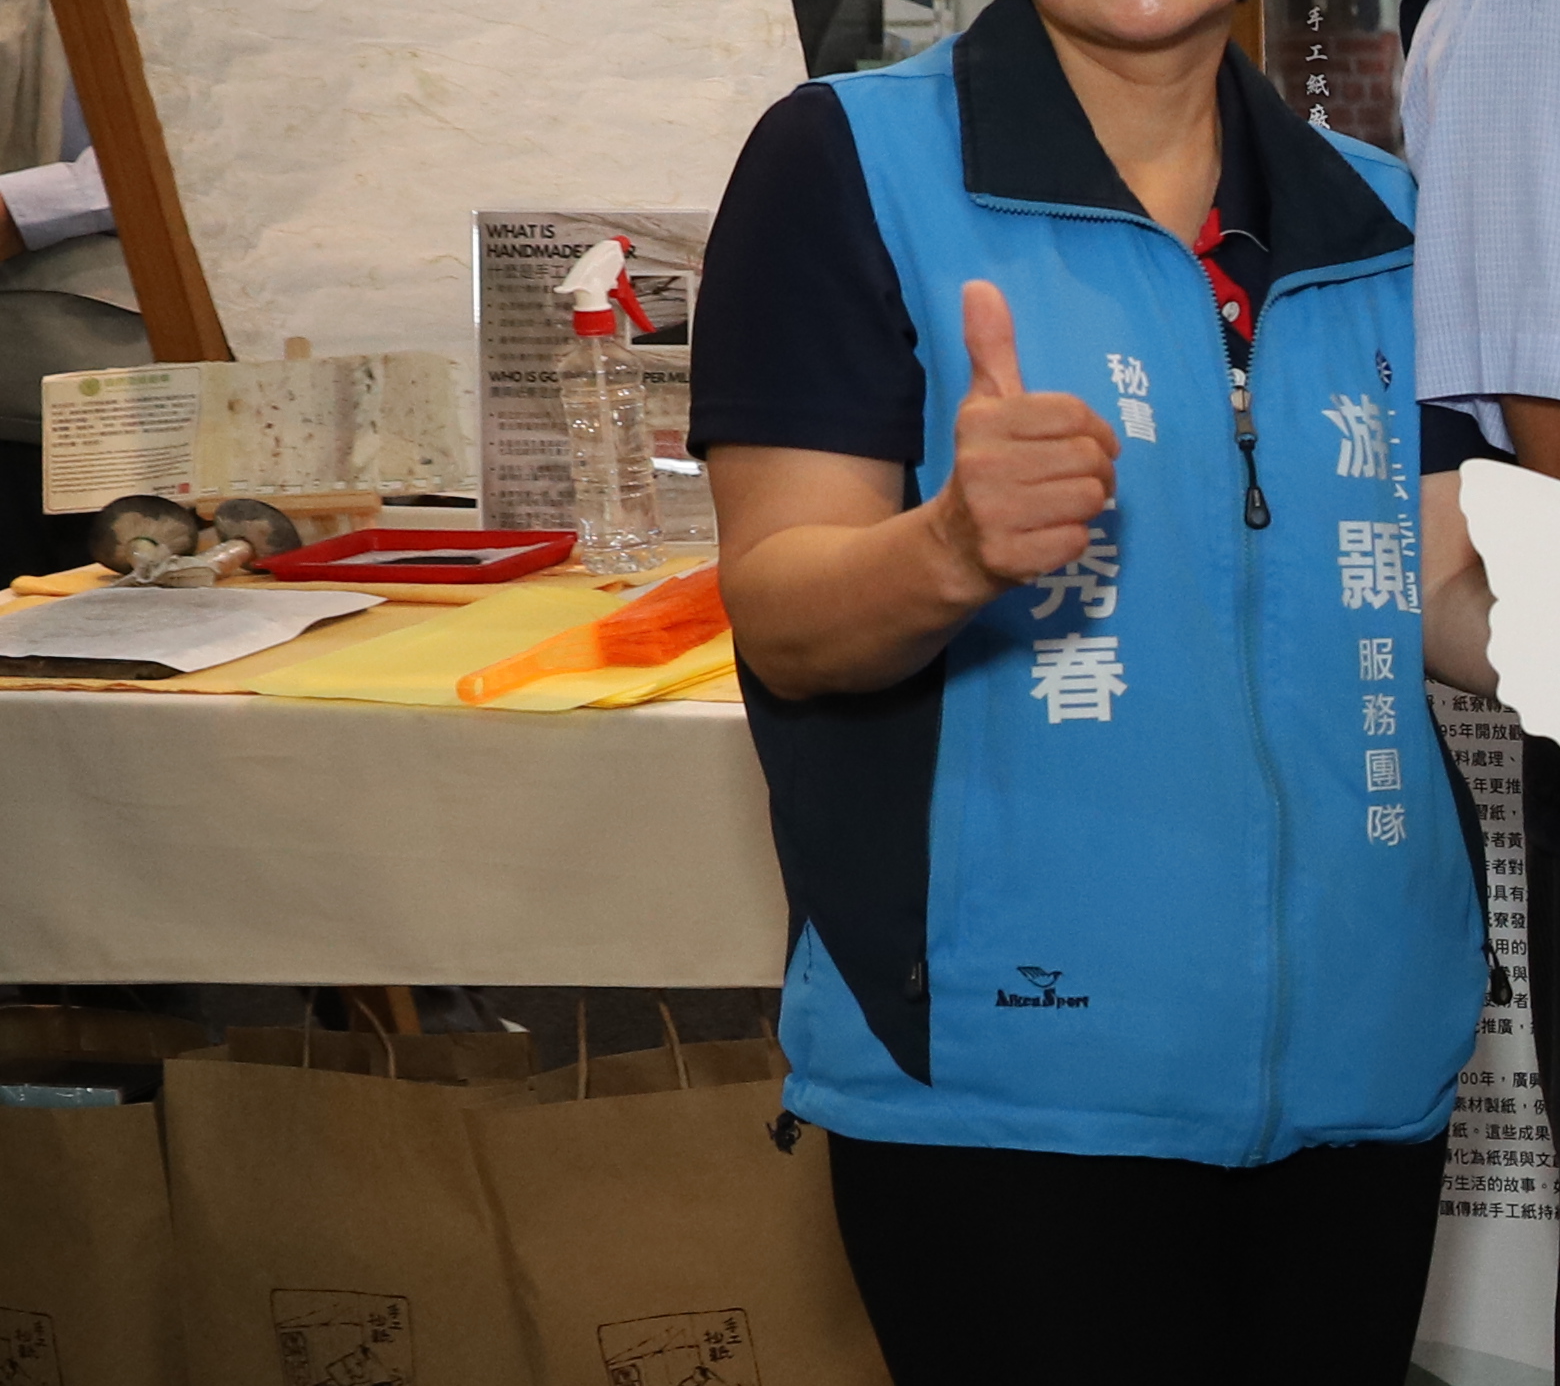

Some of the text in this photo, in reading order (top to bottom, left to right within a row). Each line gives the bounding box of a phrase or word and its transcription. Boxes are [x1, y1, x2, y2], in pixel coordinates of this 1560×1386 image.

[486, 224, 555, 239] WHAT IS
[1106, 352, 1156, 443] 秘書
[1358, 637, 1408, 847] 服務團隊
